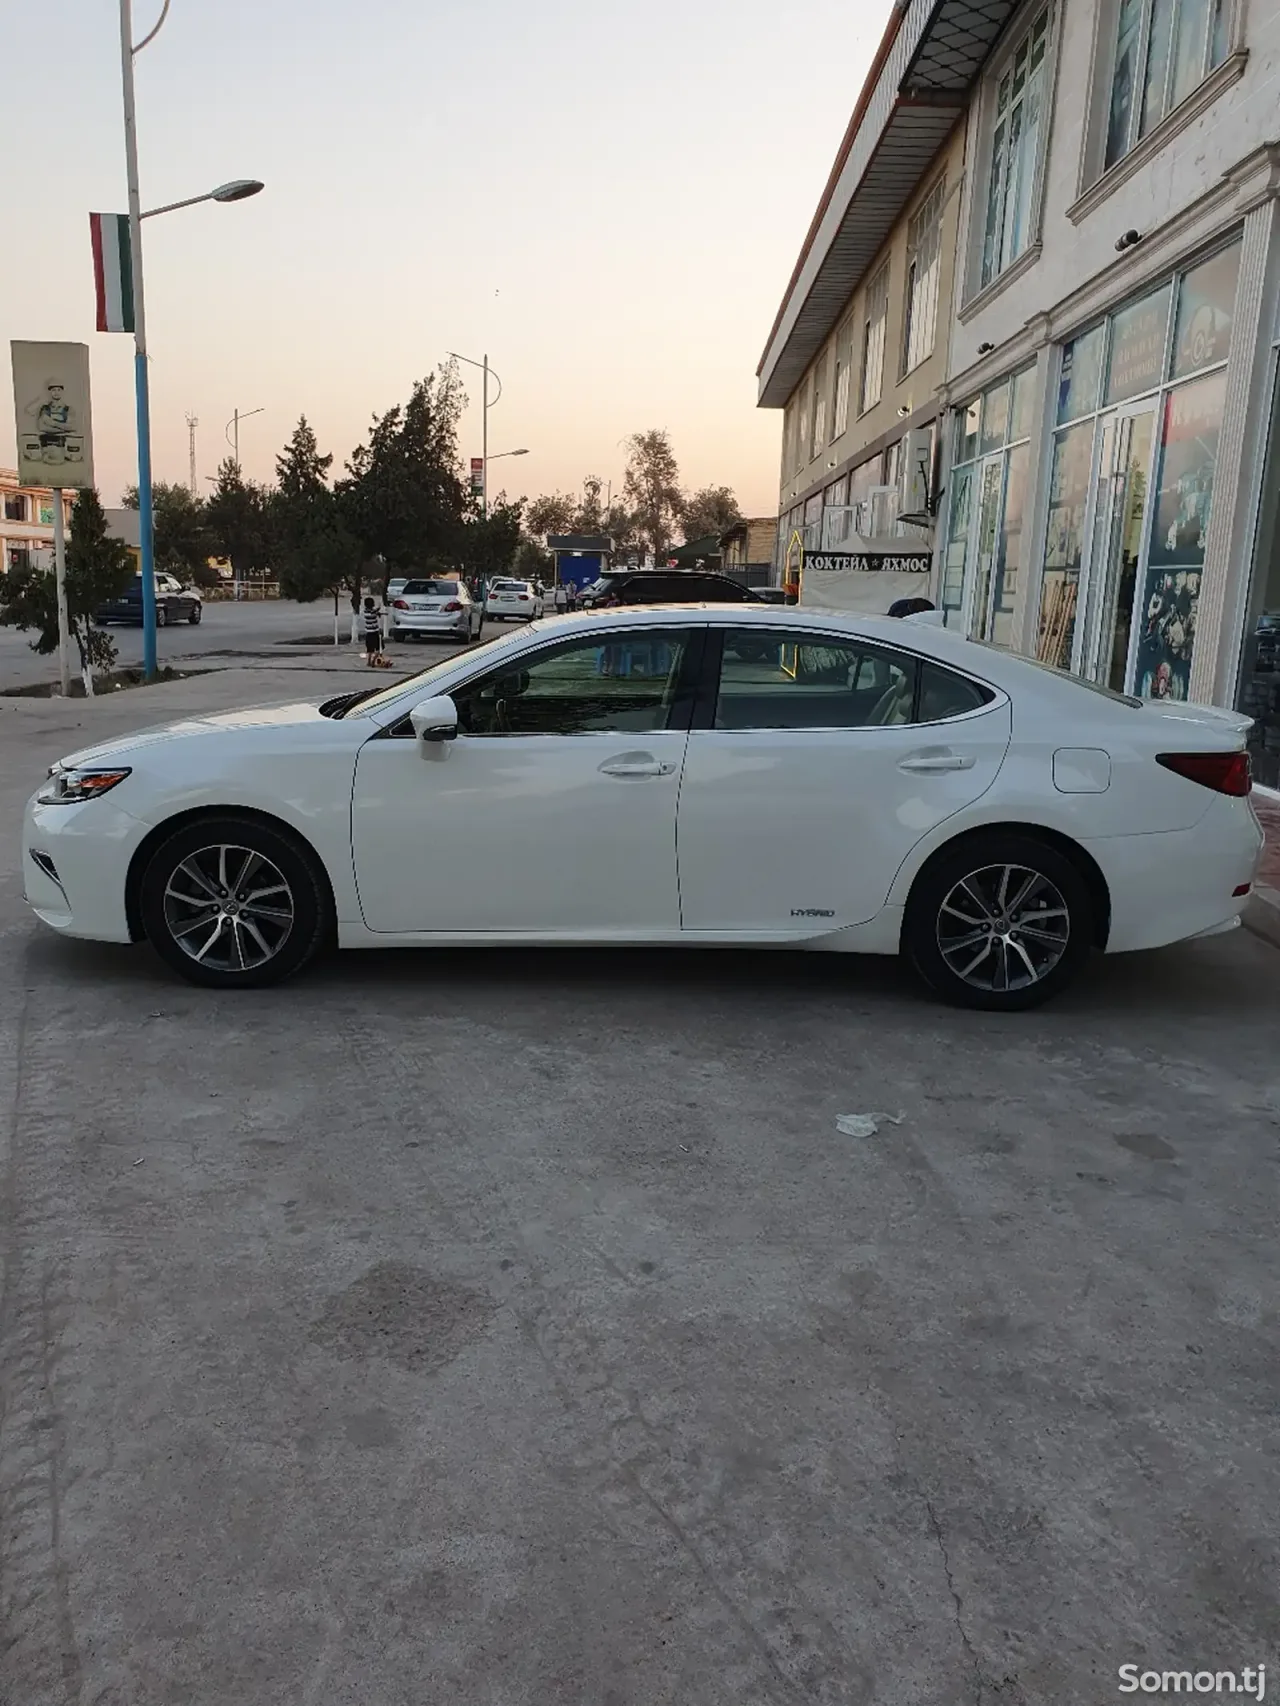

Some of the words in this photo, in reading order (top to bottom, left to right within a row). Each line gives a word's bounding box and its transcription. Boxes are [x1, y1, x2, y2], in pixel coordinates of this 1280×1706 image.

[805, 555, 869, 571] КОКТЕЙЛ
[881, 557, 929, 572] ЯХМОС
[791, 908, 835, 917] HYBRID
